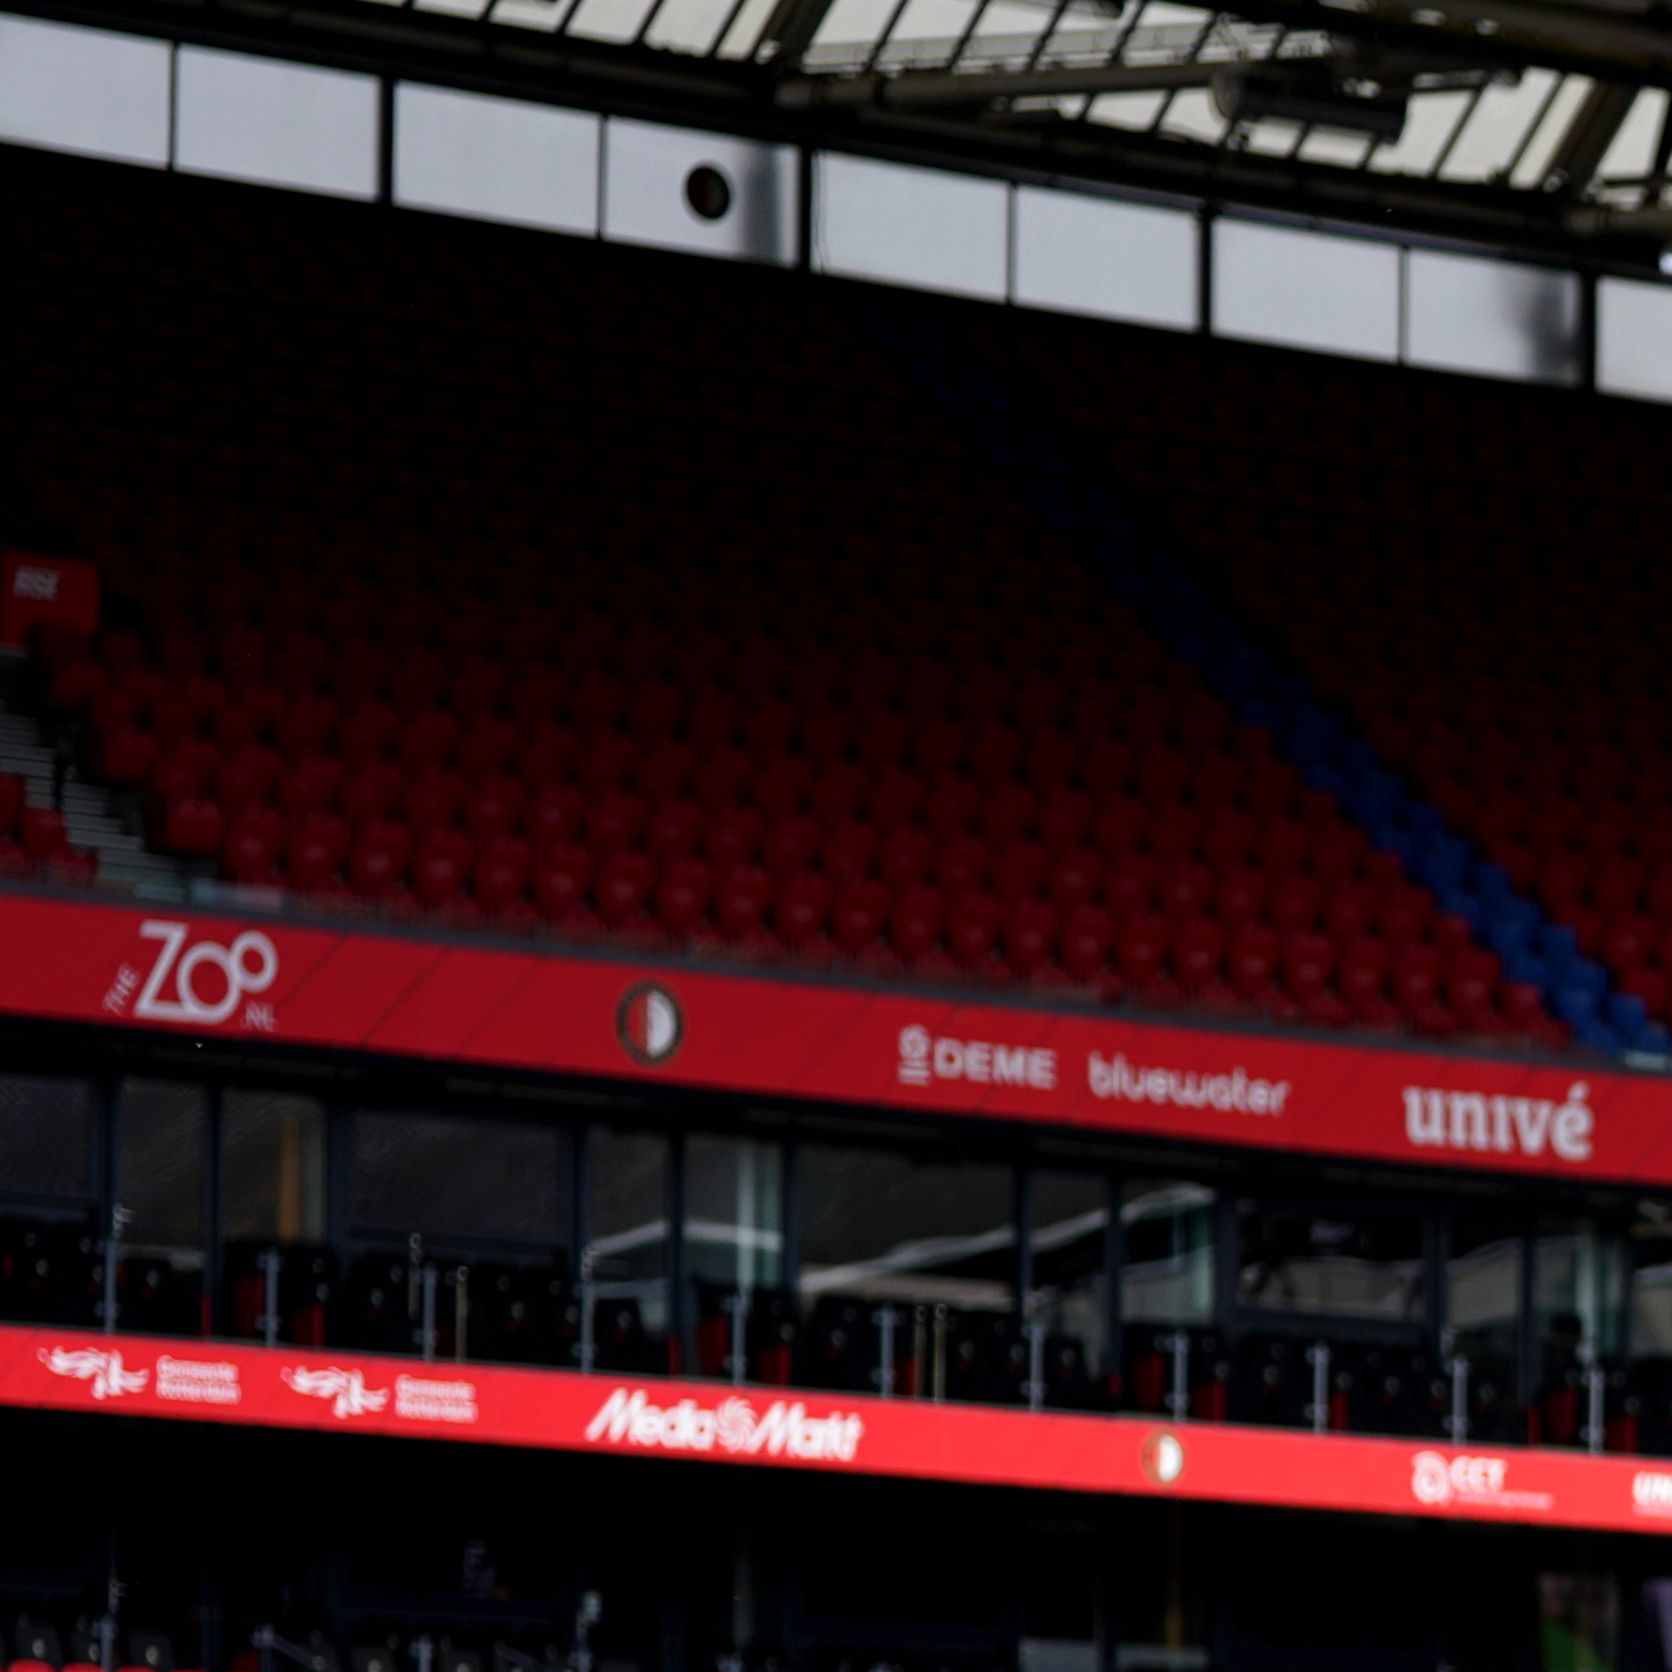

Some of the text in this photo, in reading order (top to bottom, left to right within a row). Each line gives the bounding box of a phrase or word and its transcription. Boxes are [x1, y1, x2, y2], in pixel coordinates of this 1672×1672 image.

[934, 1037, 1056, 1090] DEME
[1088, 1050, 1290, 1116] bluewater
[1402, 1081, 1595, 1161] univé
